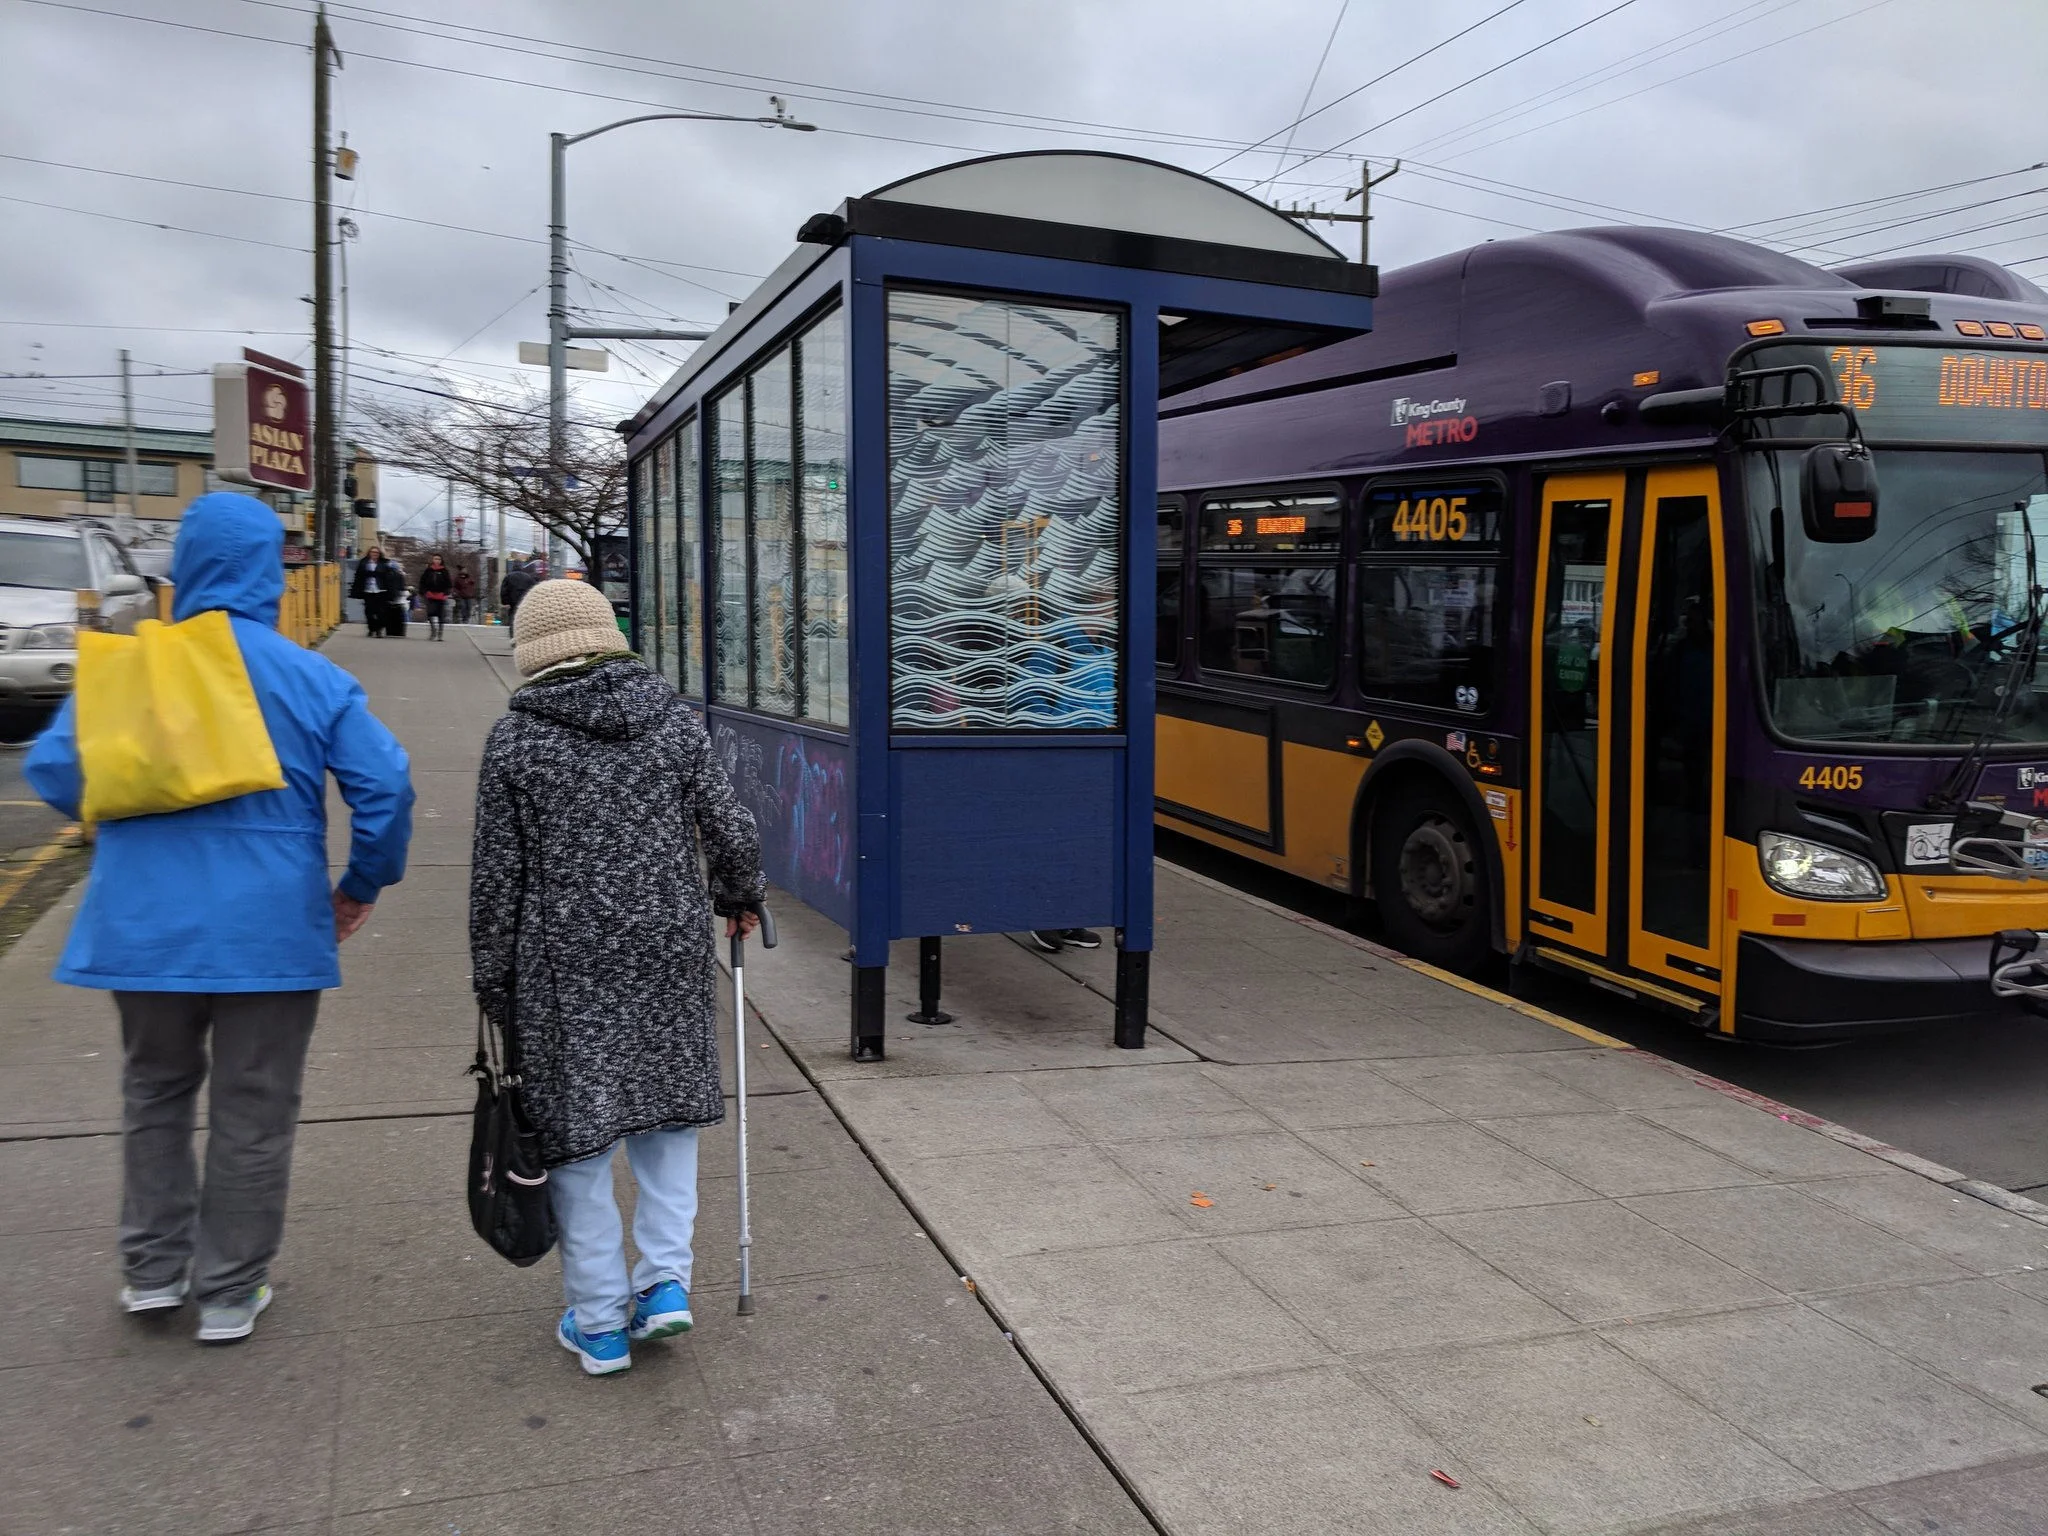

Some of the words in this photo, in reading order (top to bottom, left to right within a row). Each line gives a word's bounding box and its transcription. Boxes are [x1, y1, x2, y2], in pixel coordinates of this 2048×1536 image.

[1831, 346, 1877, 409] 36
[1939, 356, 2048, 409] DOWNTO
[1408, 403, 1431, 418] King
[1430, 398, 1467, 414] County
[250, 422, 304, 451] ASIAN
[1405, 416, 1478, 448] METRO
[250, 445, 306, 475] PLAZA
[1392, 497, 1467, 541] 4405
[1799, 766, 1863, 790] 4405
